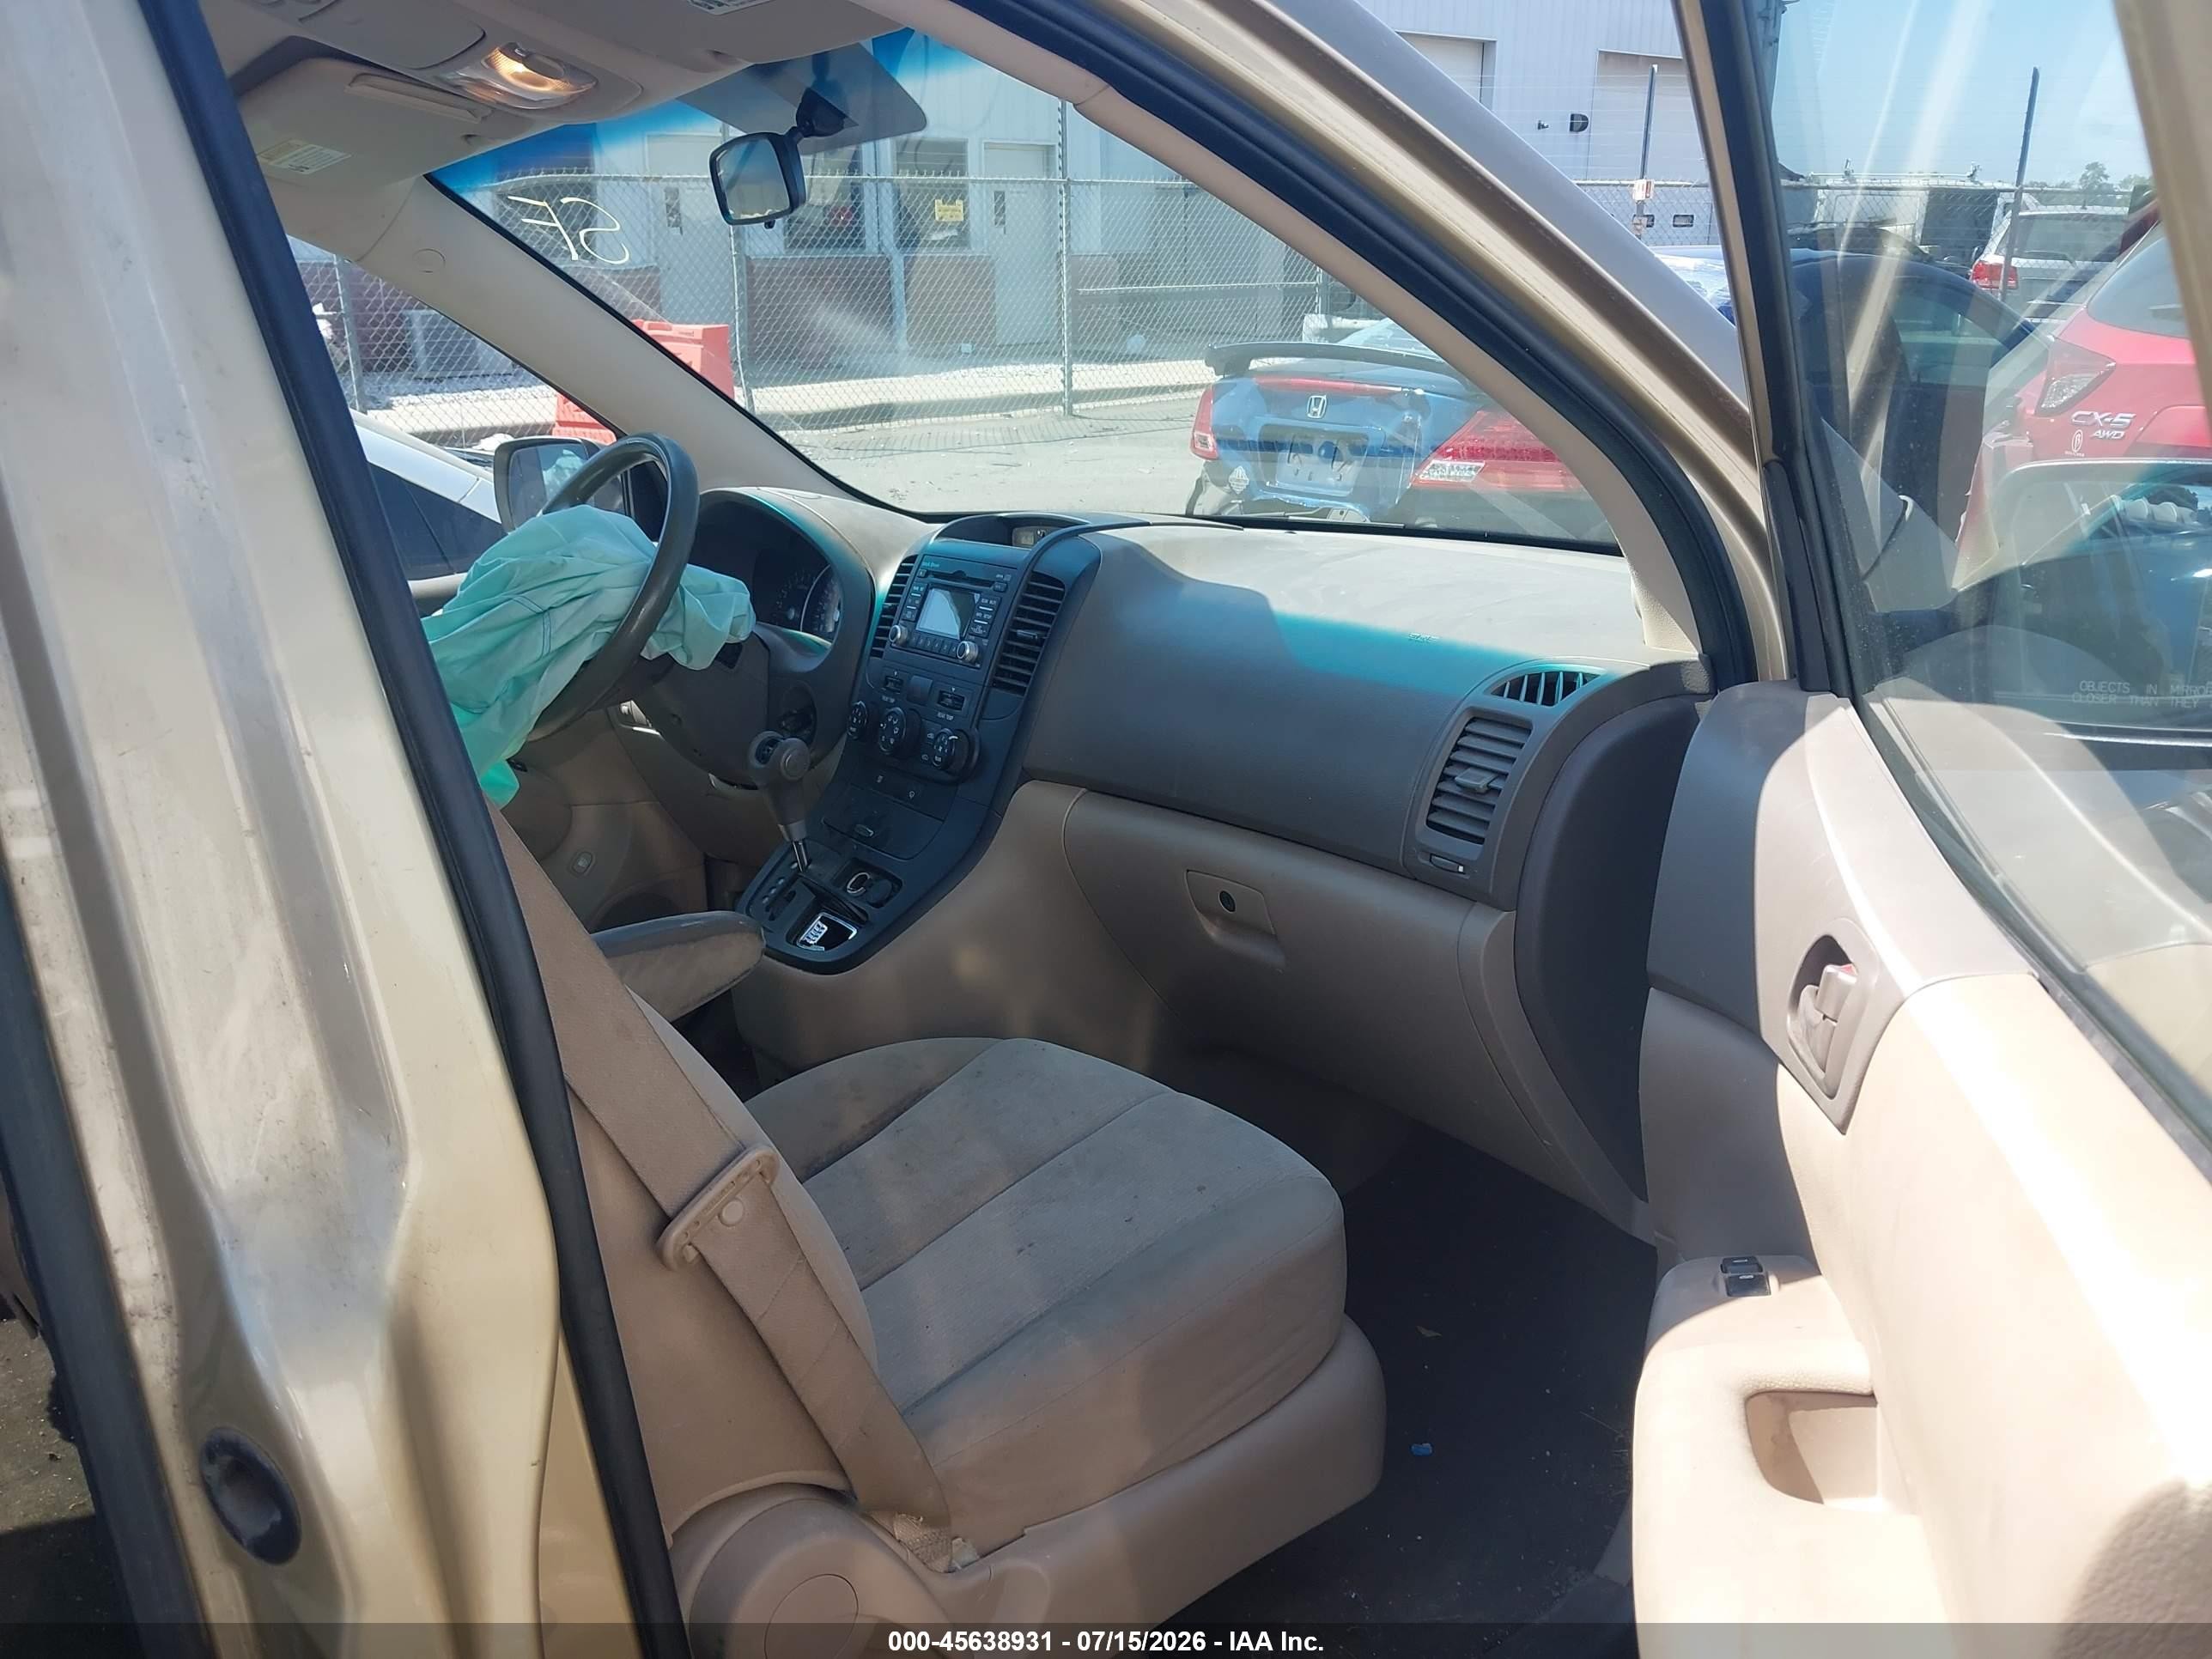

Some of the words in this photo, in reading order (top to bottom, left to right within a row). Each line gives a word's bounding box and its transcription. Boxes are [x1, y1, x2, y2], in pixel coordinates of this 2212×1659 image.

[2071, 410, 2136, 428] CX-5
[2091, 429, 2125, 440] AWD
[2080, 680, 2130, 694] OBJECTS
[2148, 684, 2158, 695] IN
[2072, 692, 2117, 704] CLOSER
[2130, 695, 2159, 707] THAN
[2170, 696, 2199, 708] THEY
